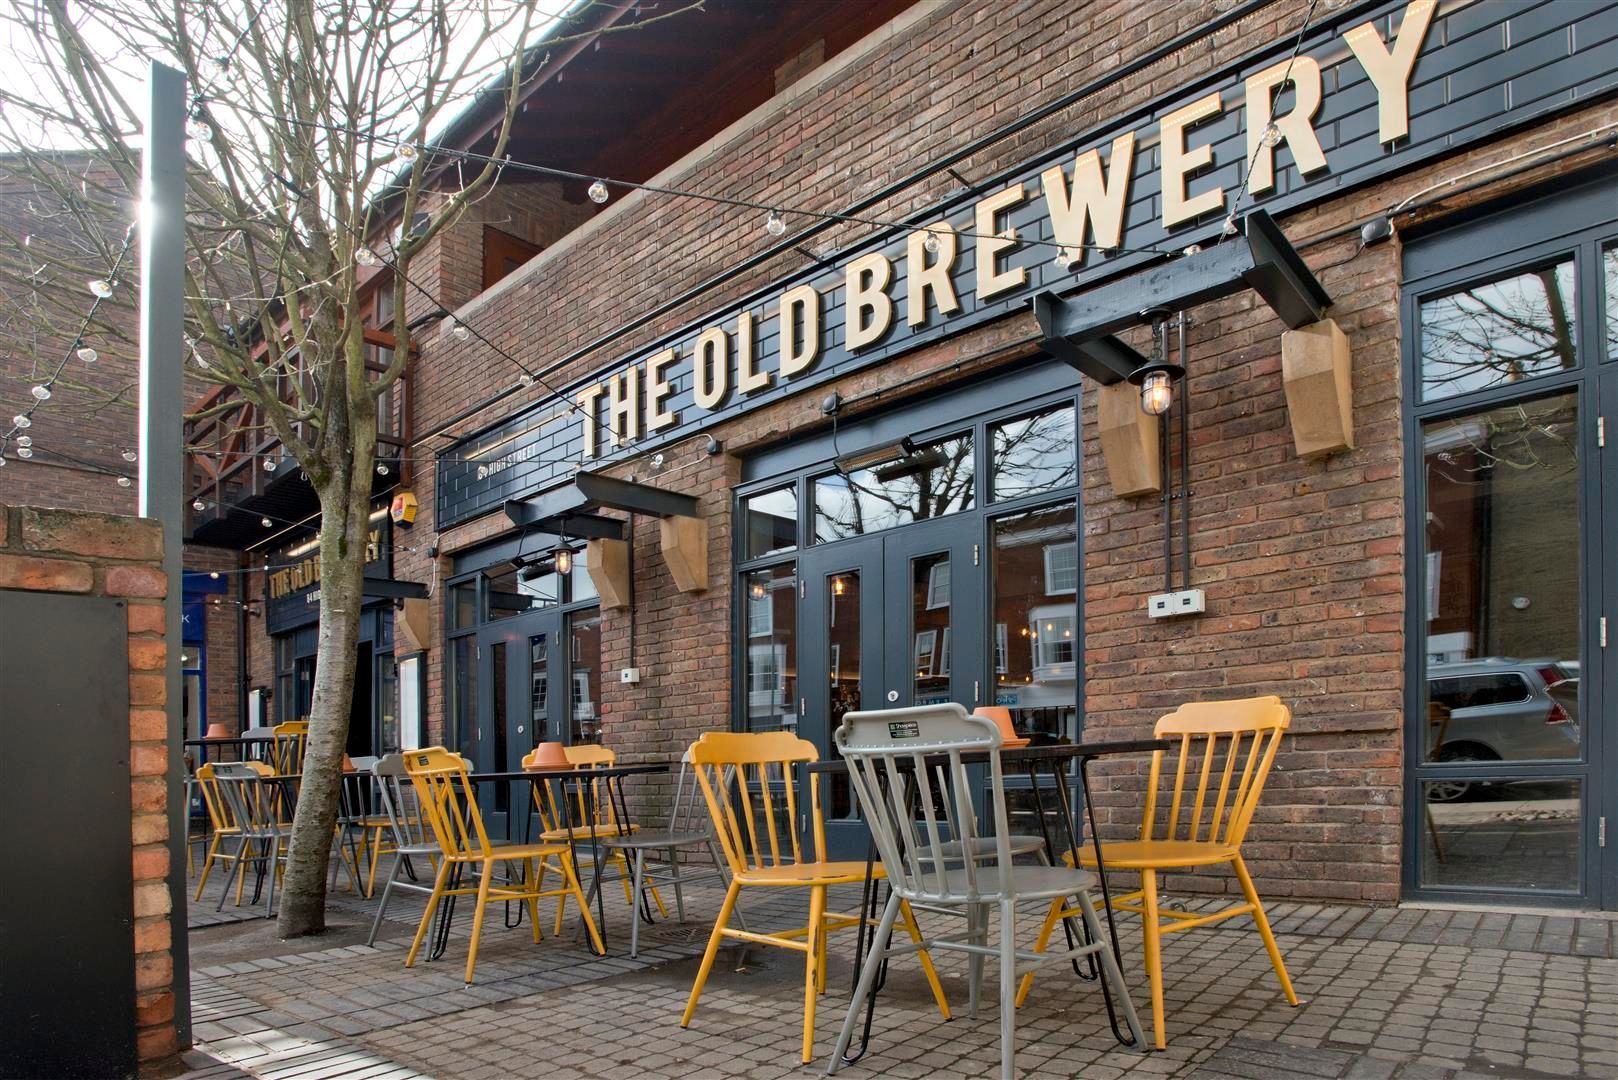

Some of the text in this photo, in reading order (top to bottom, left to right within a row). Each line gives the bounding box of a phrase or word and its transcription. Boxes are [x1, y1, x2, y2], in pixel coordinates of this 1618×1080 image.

[576, 0, 1438, 458] THE OLD BREWERY
[488, 456, 506, 476] HIGH
[507, 443, 537, 467] STREET
[269, 559, 313, 599] THE OLD
